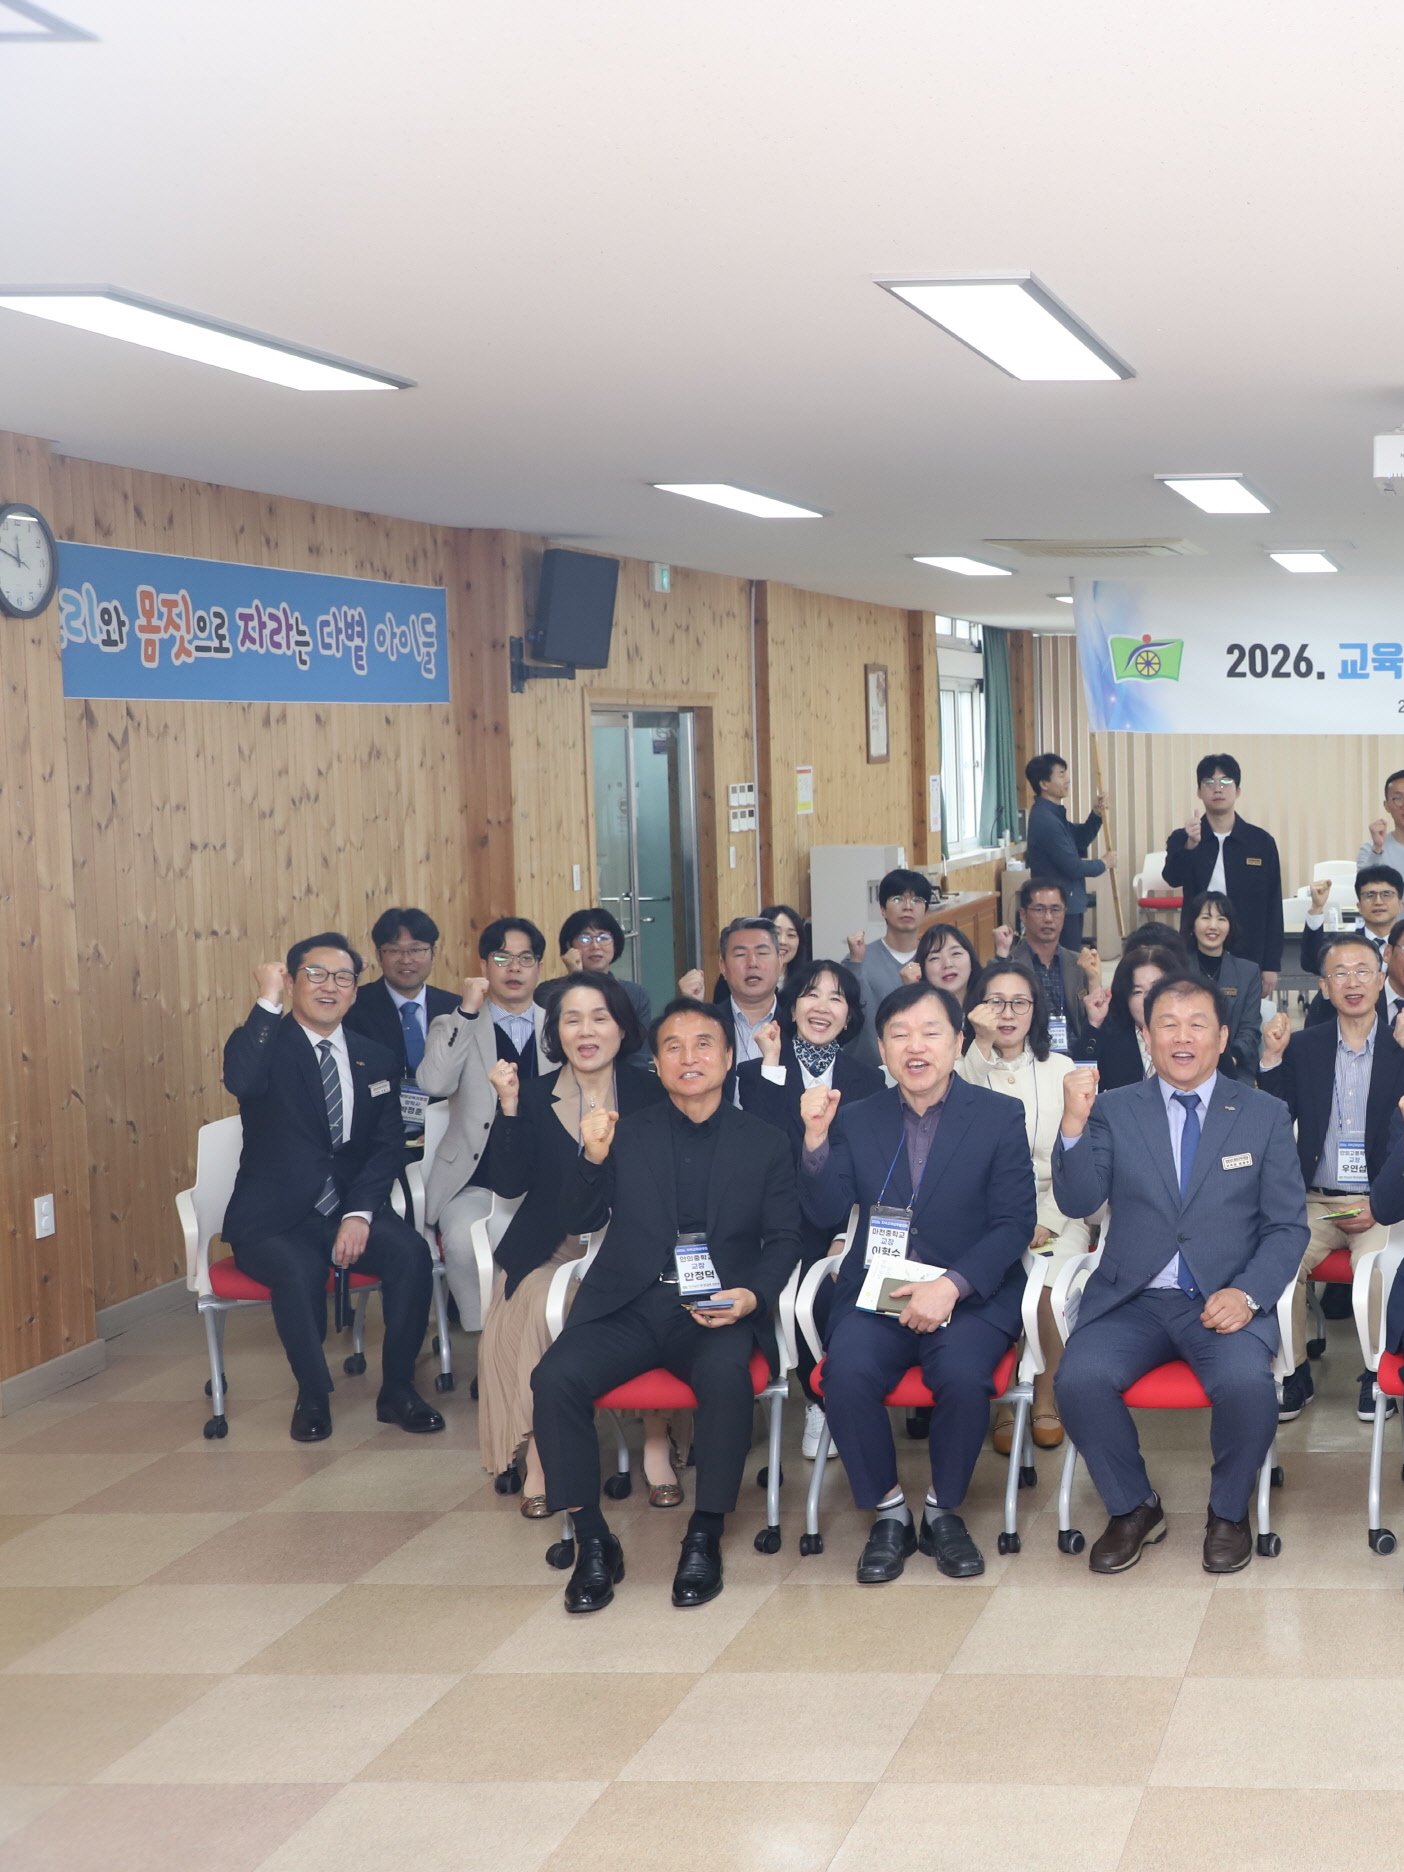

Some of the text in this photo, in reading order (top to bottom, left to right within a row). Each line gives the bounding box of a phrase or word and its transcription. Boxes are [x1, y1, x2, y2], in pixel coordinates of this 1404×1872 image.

[60, 584, 437, 679] 리와 몸짓으로 자라는 다볕 아이들
[1226, 643, 1326, 680] 2026.
[872, 1227, 905, 1238] 마천중학교
[881, 1238, 894, 1246] 교장
[684, 1270, 715, 1281] 안정덕
